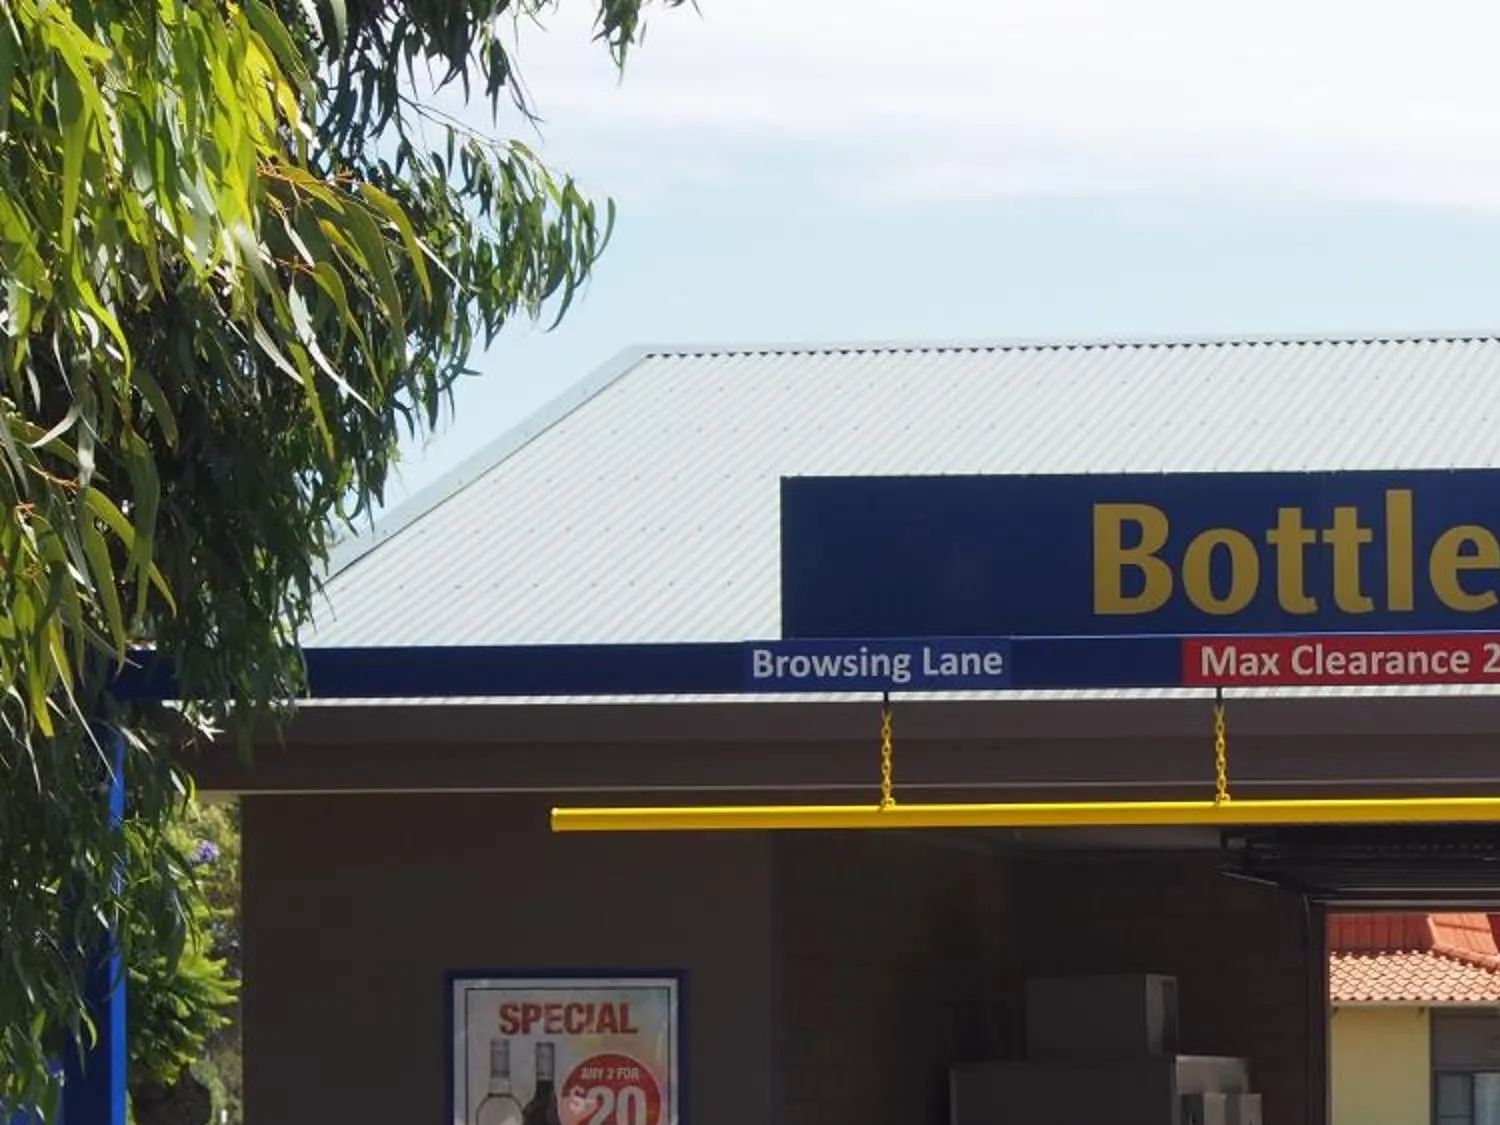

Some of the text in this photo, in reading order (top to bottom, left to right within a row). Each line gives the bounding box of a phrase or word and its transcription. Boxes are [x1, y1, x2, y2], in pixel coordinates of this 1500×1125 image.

[753, 645, 1004, 684] Browsing Lane
[1200, 645, 1280, 676] Max
[1291, 642, 1471, 676] Clearance
[499, 1002, 638, 1036] SPECIAL
